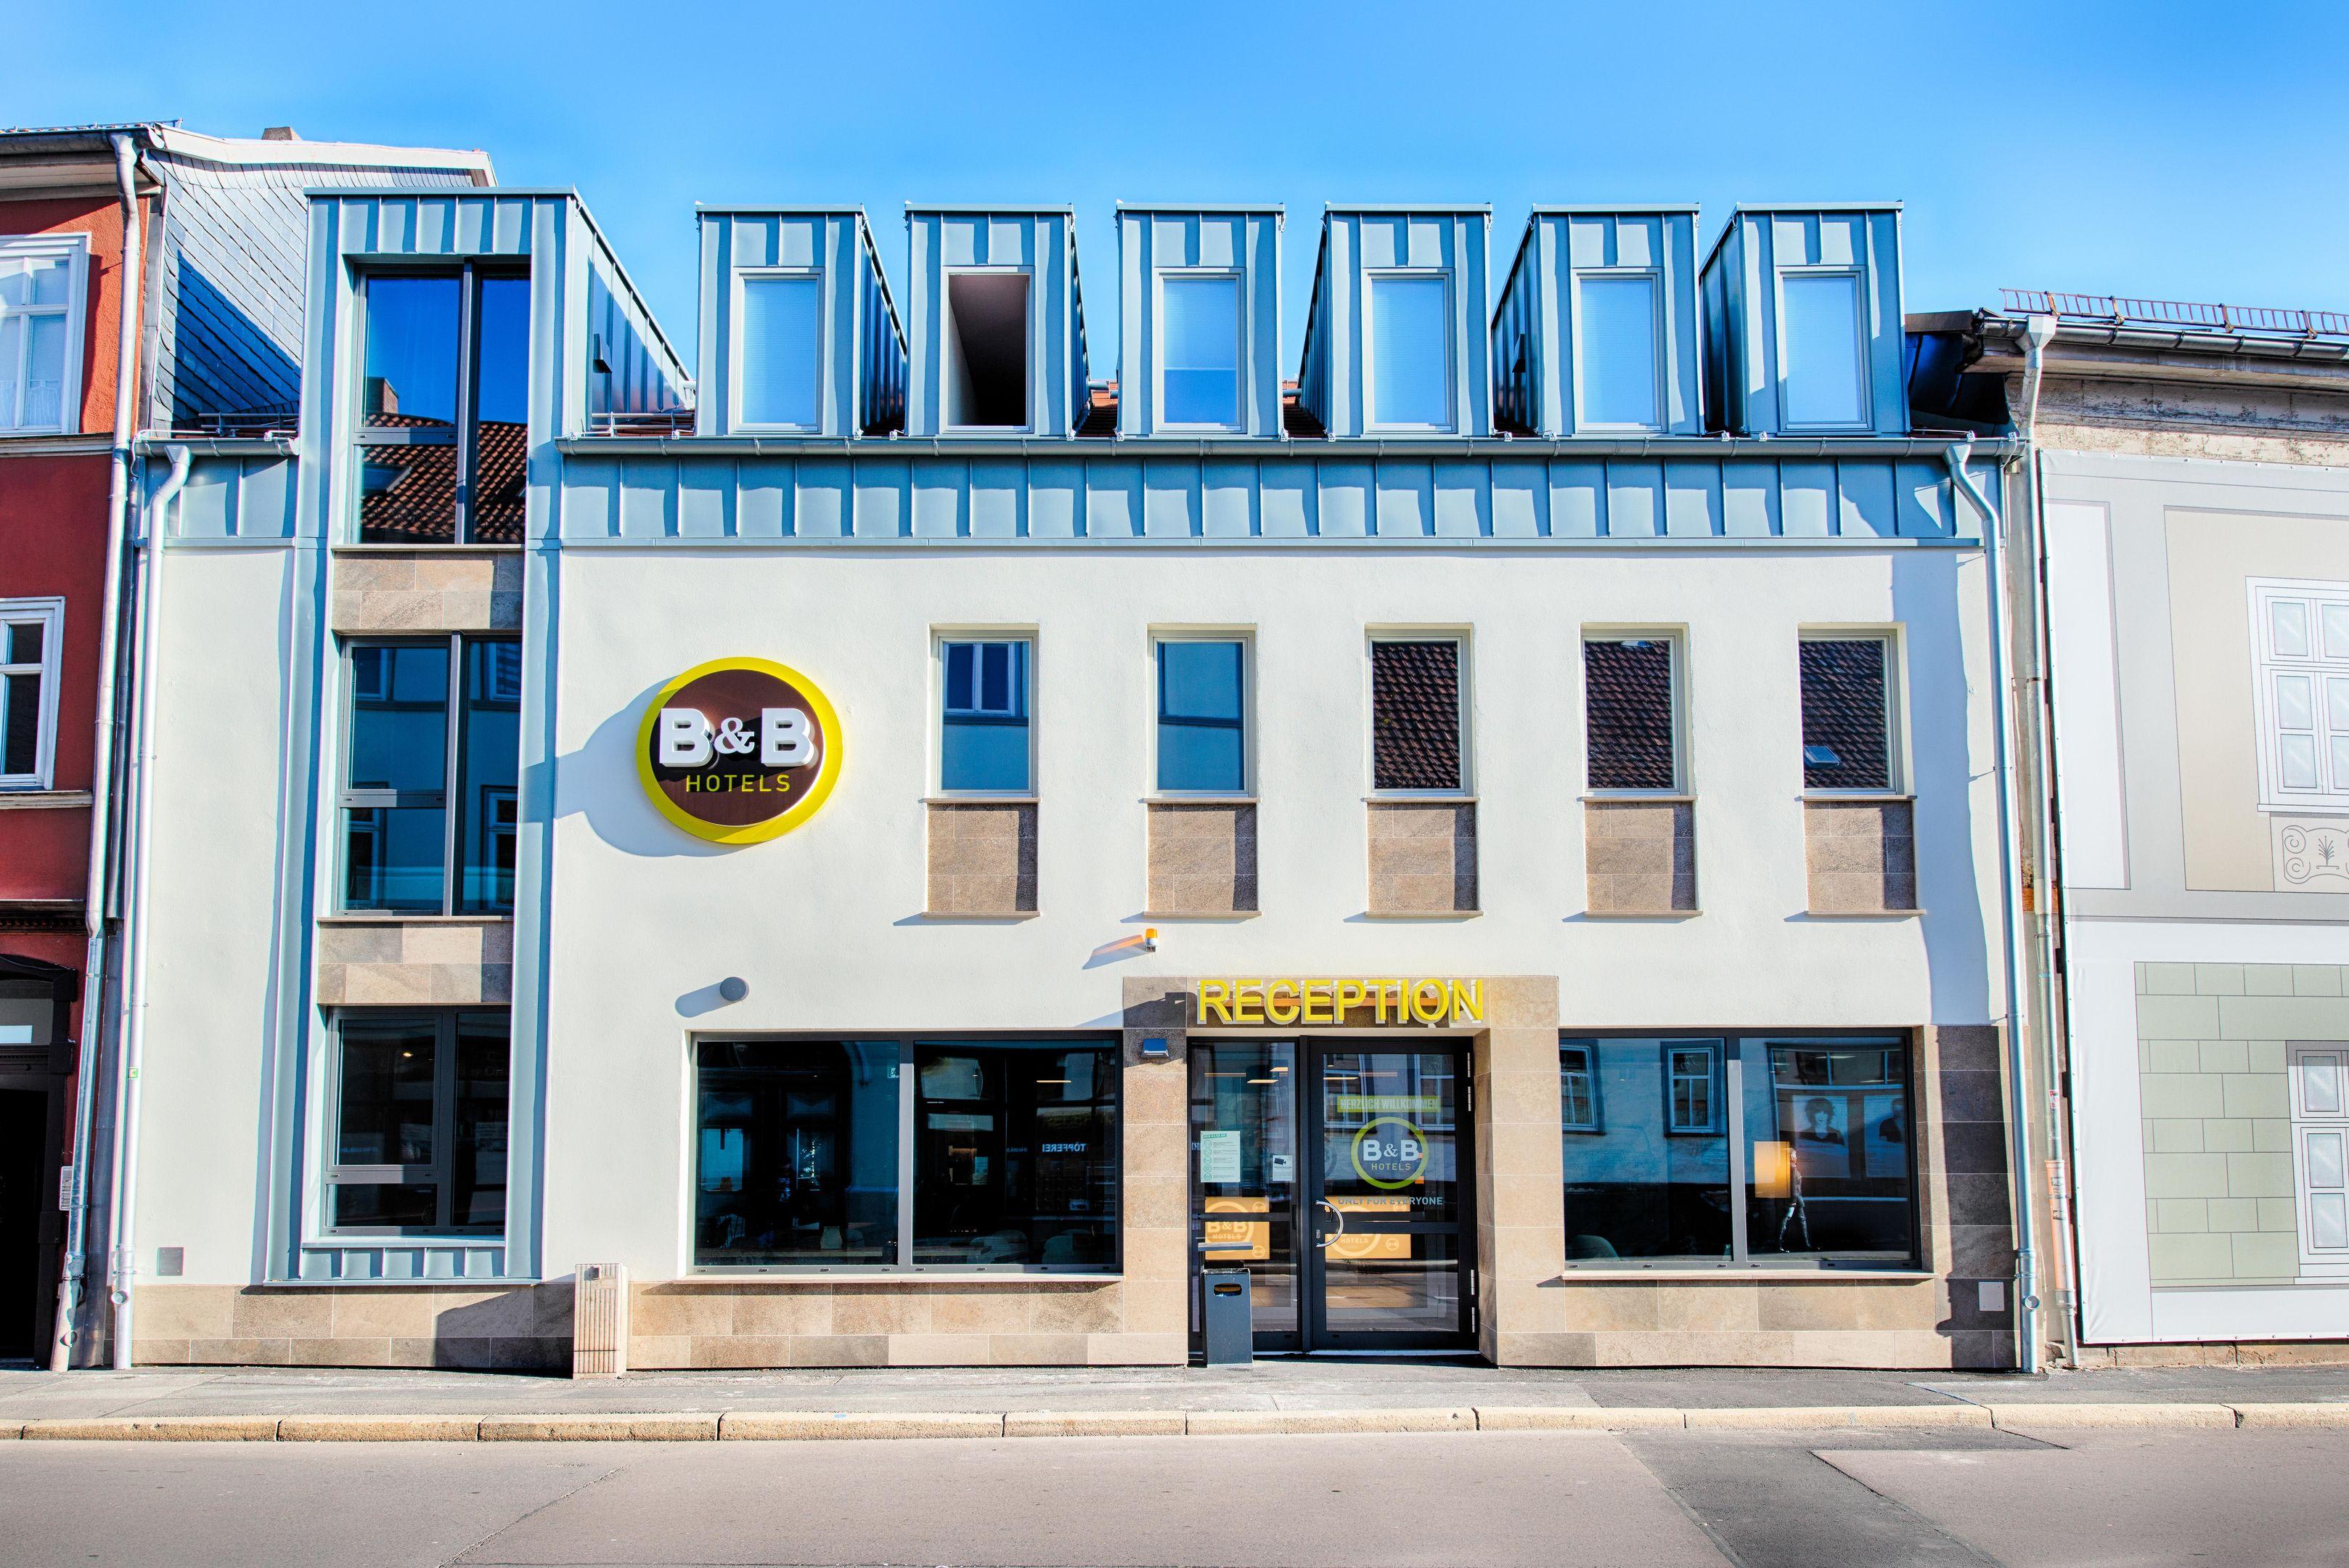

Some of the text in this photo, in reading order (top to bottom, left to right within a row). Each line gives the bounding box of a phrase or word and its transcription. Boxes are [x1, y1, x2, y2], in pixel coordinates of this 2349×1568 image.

[659, 708, 817, 767] B&B
[685, 774, 791, 792] HOTELS
[1196, 978, 1483, 1024] RECEPTION
[1340, 1098, 1439, 1110] HERZLICH WILLKOMMEN
[1363, 1139, 1419, 1161] B&B
